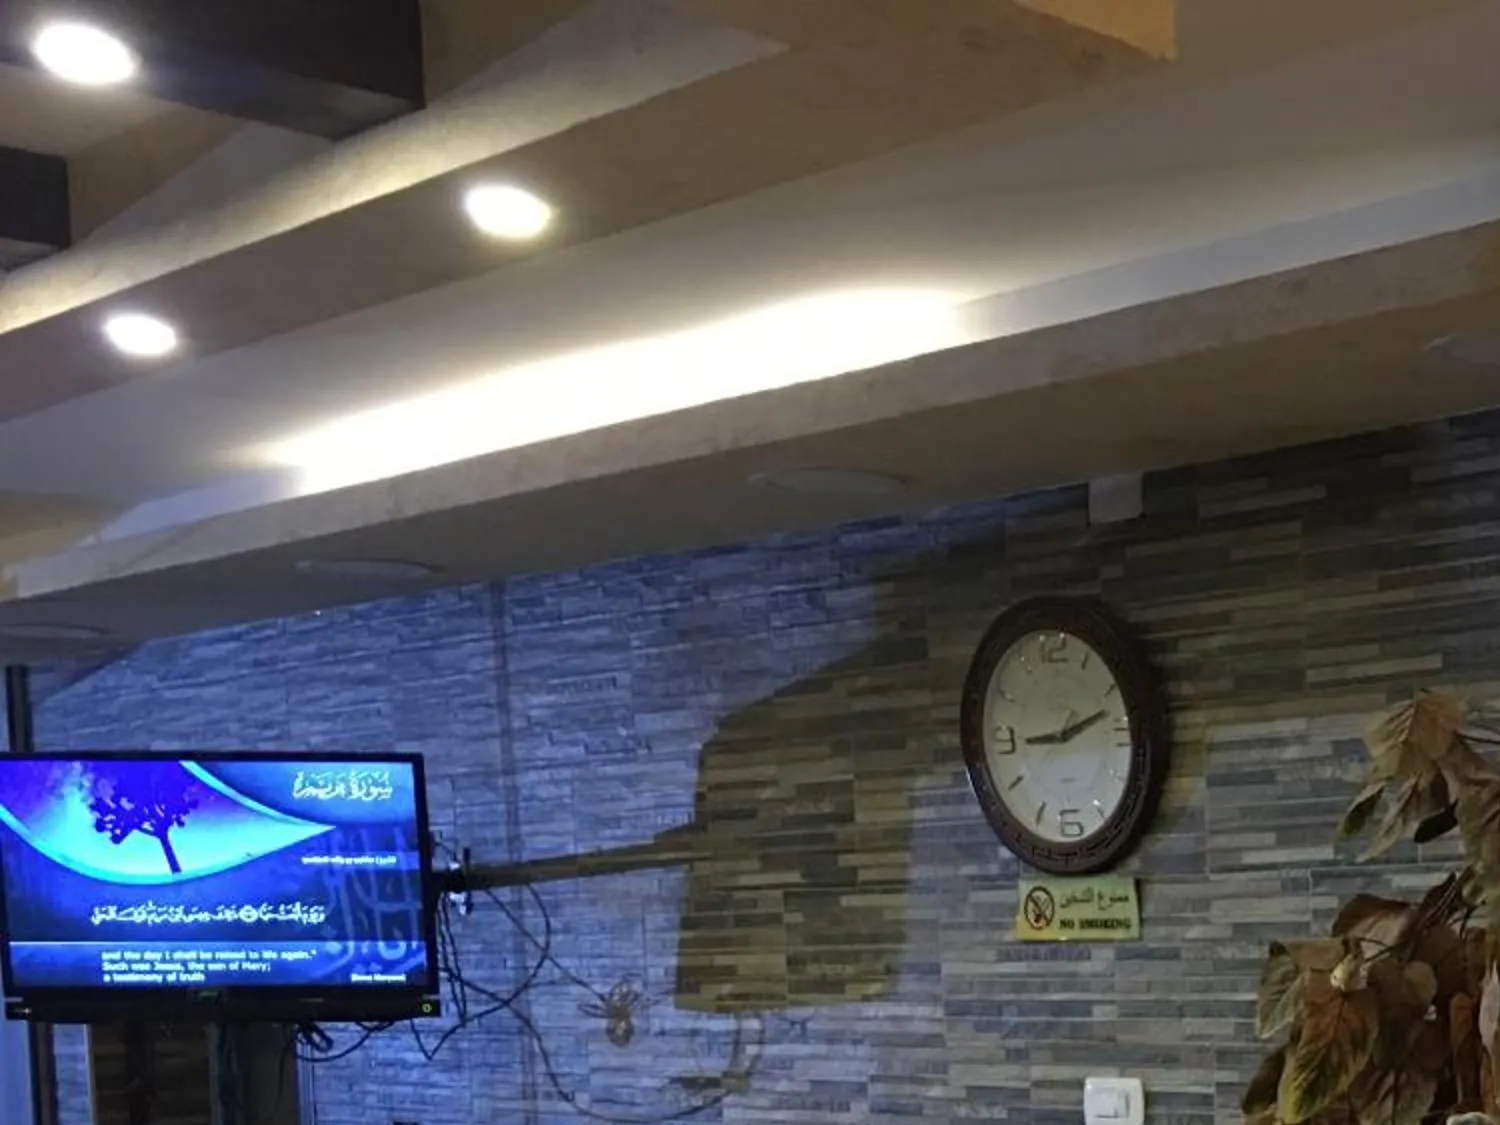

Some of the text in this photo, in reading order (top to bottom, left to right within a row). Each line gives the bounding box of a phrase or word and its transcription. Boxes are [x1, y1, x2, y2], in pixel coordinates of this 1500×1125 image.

[1039, 633, 1069, 663] 12
[996, 725, 1016, 755] 9
[1059, 809, 1084, 837] 6
[1059, 918, 1132, 930] NO SMOKING
[124, 951, 141, 960] the
[143, 951, 162, 961] day
[103, 962, 128, 971] Such
[188, 962, 204, 971] the
